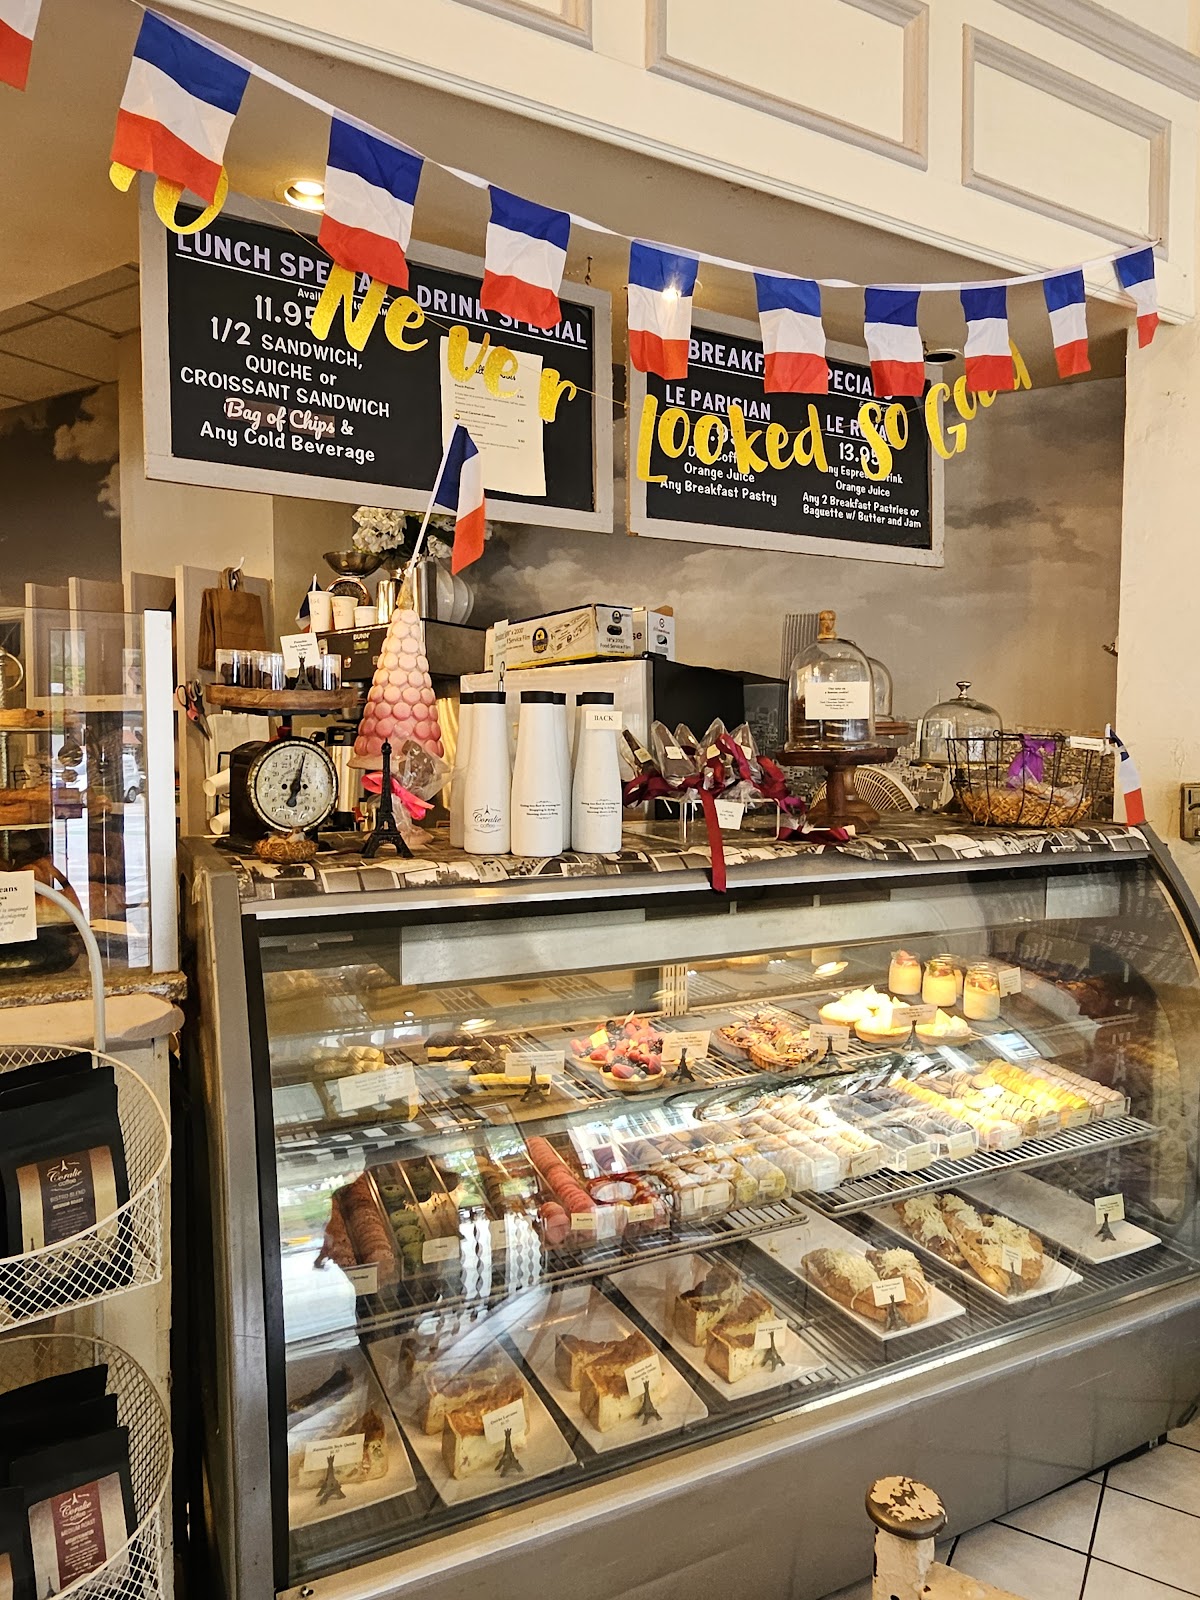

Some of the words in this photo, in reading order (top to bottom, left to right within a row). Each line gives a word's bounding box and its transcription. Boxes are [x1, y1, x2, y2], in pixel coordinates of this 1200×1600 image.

[177, 231, 271, 272] LUNCH
[255, 295, 316, 330] 11.95
[417, 285, 489, 323] DRINK
[210, 316, 251, 346] 1/2
[261, 334, 363, 370] SANDWICH,
[312, 262, 577, 422] Never
[688, 339, 766, 373] BREAKF
[246, 355, 313, 382] QUICHE
[319, 373, 338, 386] or
[180, 367, 290, 401] CROISSANT
[296, 388, 390, 418] SANDWICH
[666, 384, 686, 406] LE
[224, 397, 262, 430] Bag
[267, 406, 287, 432] of
[289, 410, 336, 440] Chips
[340, 419, 354, 436] &
[826, 414, 844, 434] LE
[200, 420, 238, 447] Any
[244, 429, 285, 450] Cold
[291, 434, 375, 465] Beverage
[637, 394, 828, 482] Looked
[857, 402, 909, 481] So
[684, 462, 723, 481] Orange
[726, 469, 755, 483] Juice
[828, 465, 839, 477] ny
[886, 473, 904, 484] rink
[835, 479, 866, 496] Orange
[868, 484, 891, 497] Juice
[660, 480, 682, 495] Any
[685, 480, 739, 498] Breakfast
[742, 488, 777, 506] Pastry
[802, 492, 820, 506] Any
[821, 494, 828, 505] 2
[830, 496, 871, 511] Breakfast
[874, 502, 908, 516] Pastries
[910, 508, 920, 517] or
[803, 504, 844, 518] Baguette
[845, 510, 856, 521] w/
[858, 511, 886, 524] Butter
[887, 516, 902, 526] and
[904, 518, 922, 528] Jam
[47, 1167, 82, 1183] Coralie
[59, 1500, 92, 1518] Coralie
